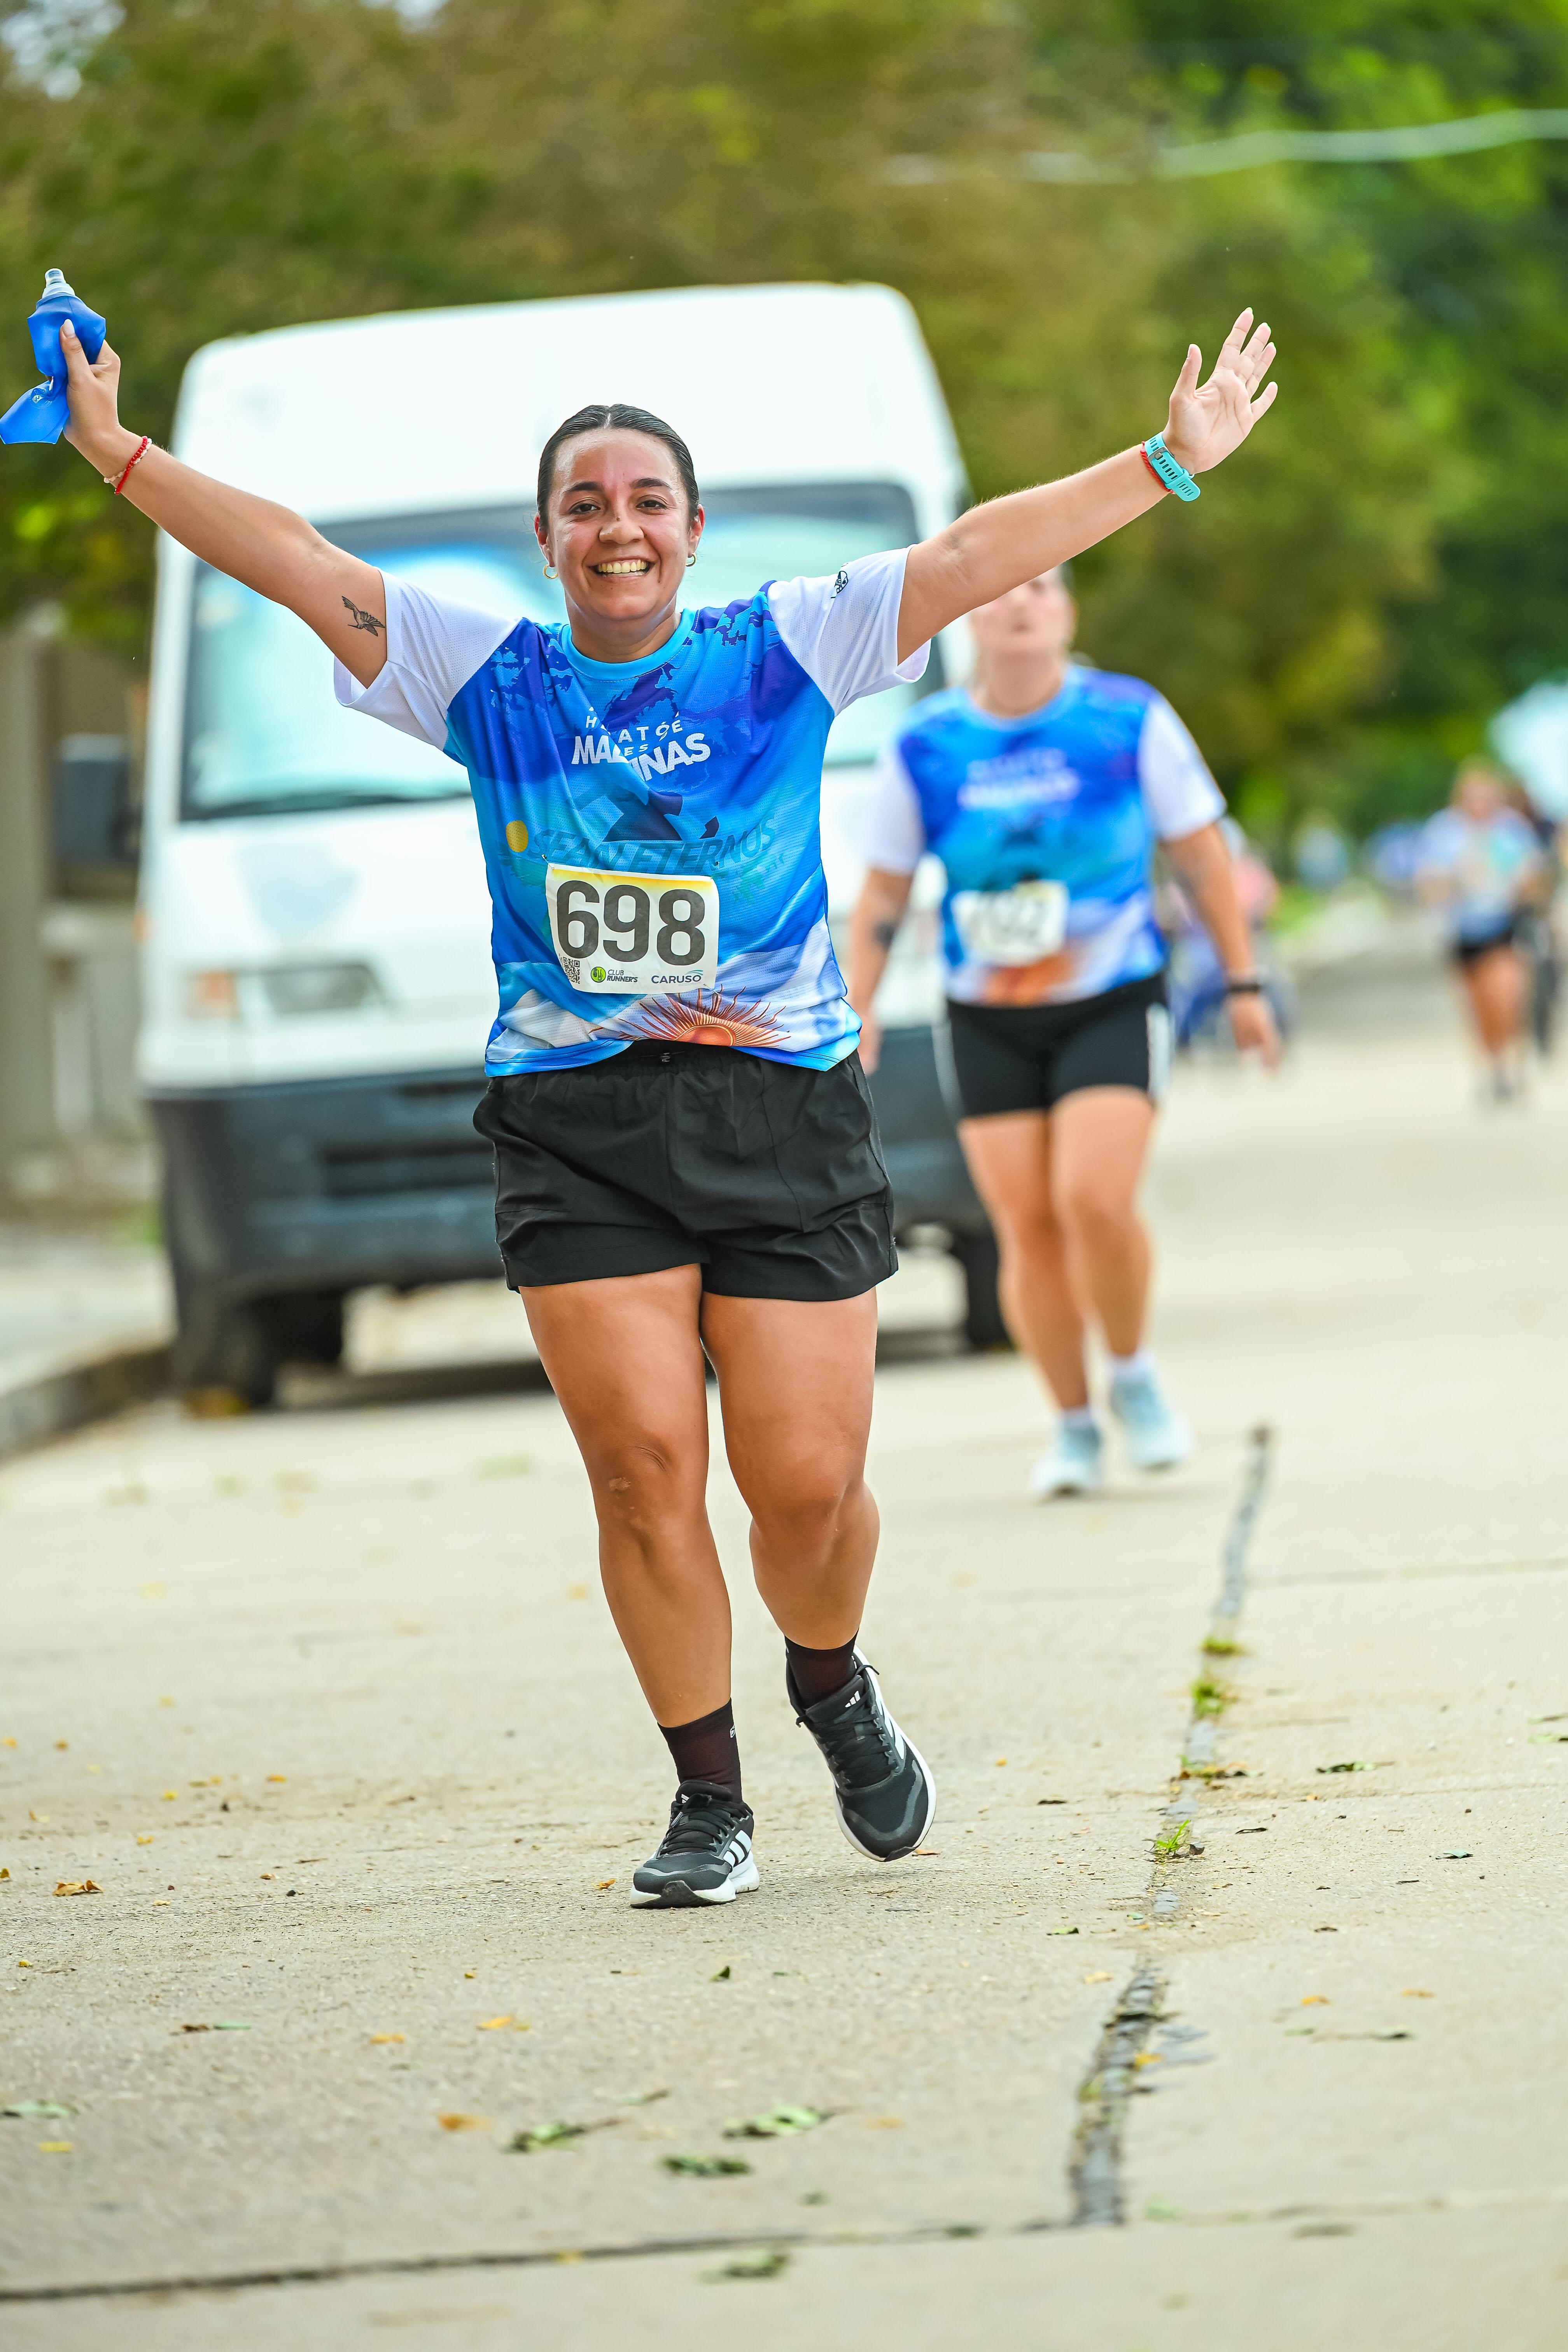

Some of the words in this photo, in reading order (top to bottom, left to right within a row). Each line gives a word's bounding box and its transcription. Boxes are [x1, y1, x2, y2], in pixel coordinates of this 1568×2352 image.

[571, 733, 711, 781] MALINAS
[625, 818, 777, 874] ETERNOS
[556, 880, 705, 966] 698
[651, 975, 702, 984] CARUSO
